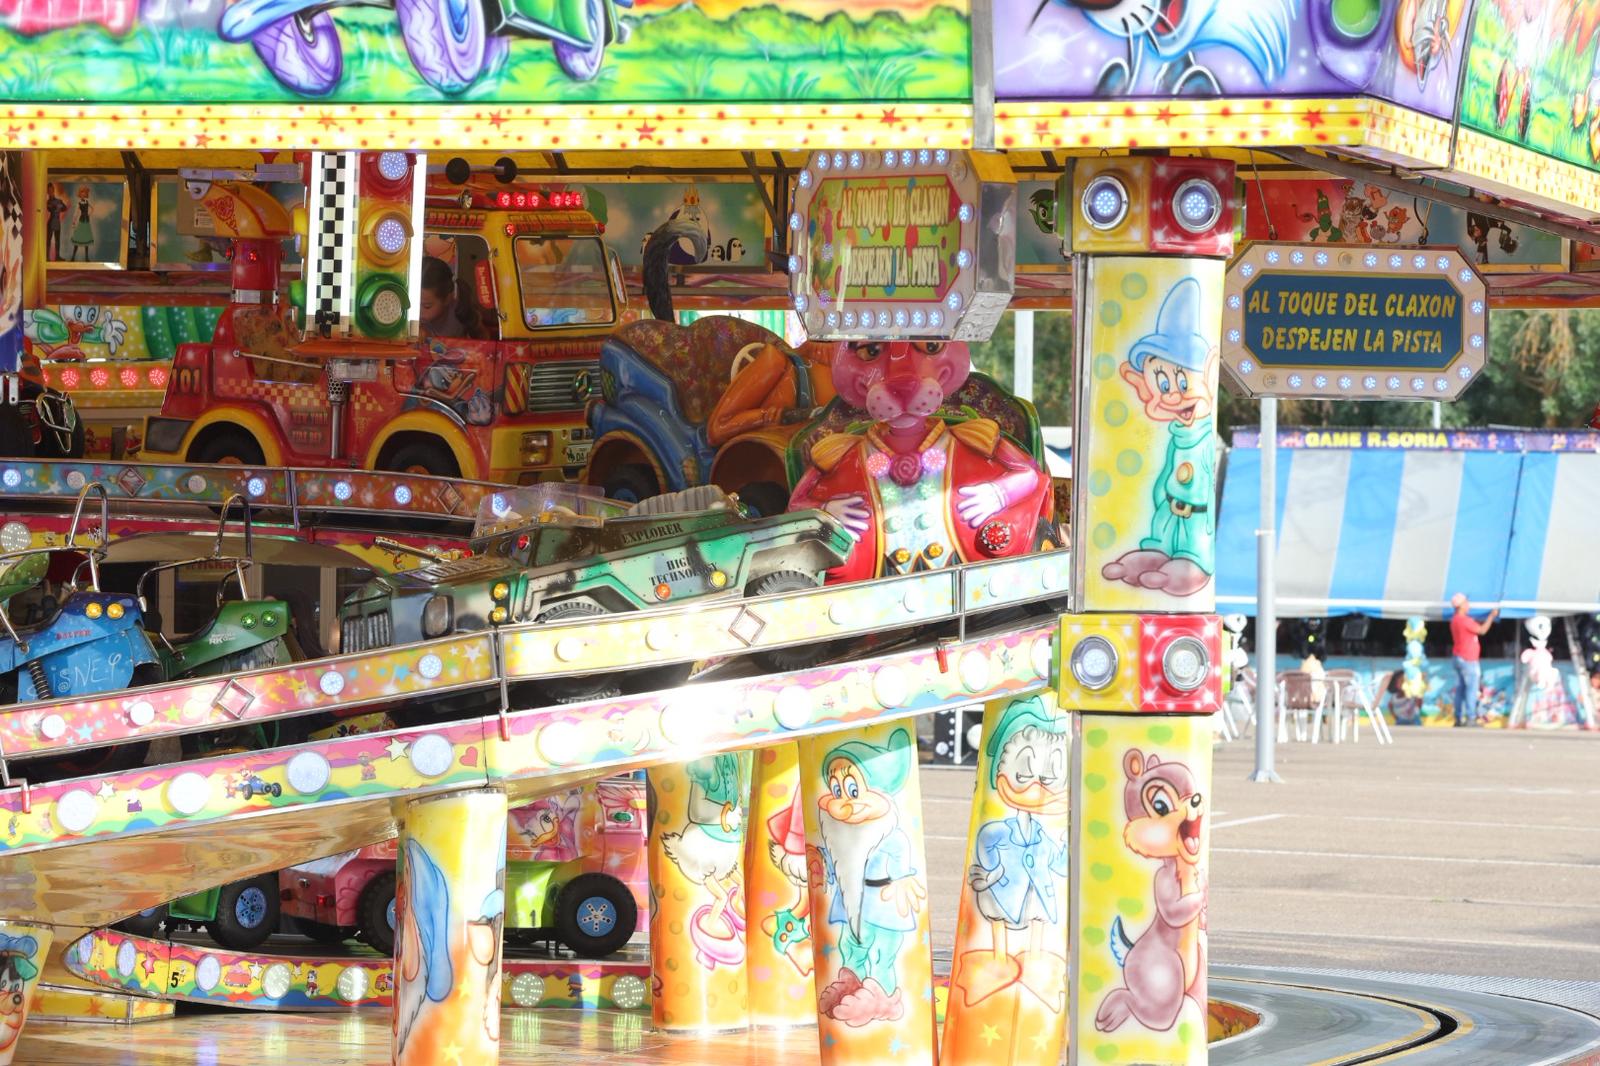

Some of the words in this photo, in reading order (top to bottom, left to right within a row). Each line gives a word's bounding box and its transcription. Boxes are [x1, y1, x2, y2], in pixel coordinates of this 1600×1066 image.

[841, 187, 854, 228] AL
[856, 187, 889, 236] TOQUE
[909, 185, 950, 228] CLAXON
[895, 246, 909, 287] LA
[911, 246, 940, 287] PISTA
[1249, 290, 1271, 314] AL
[1278, 291, 1339, 317] TOQUE
[1344, 293, 1379, 317] DEL
[1385, 293, 1457, 318] CLAXON
[1262, 326, 1358, 352] DESPEJEN
[1363, 328, 1386, 352] LA
[1391, 329, 1443, 353] PISTA
[1305, 432, 1362, 448] GAME
[1367, 432, 1449, 448] R.SORIA
[622, 522, 684, 544] EXPLORER
[170, 971, 180, 989] 5
